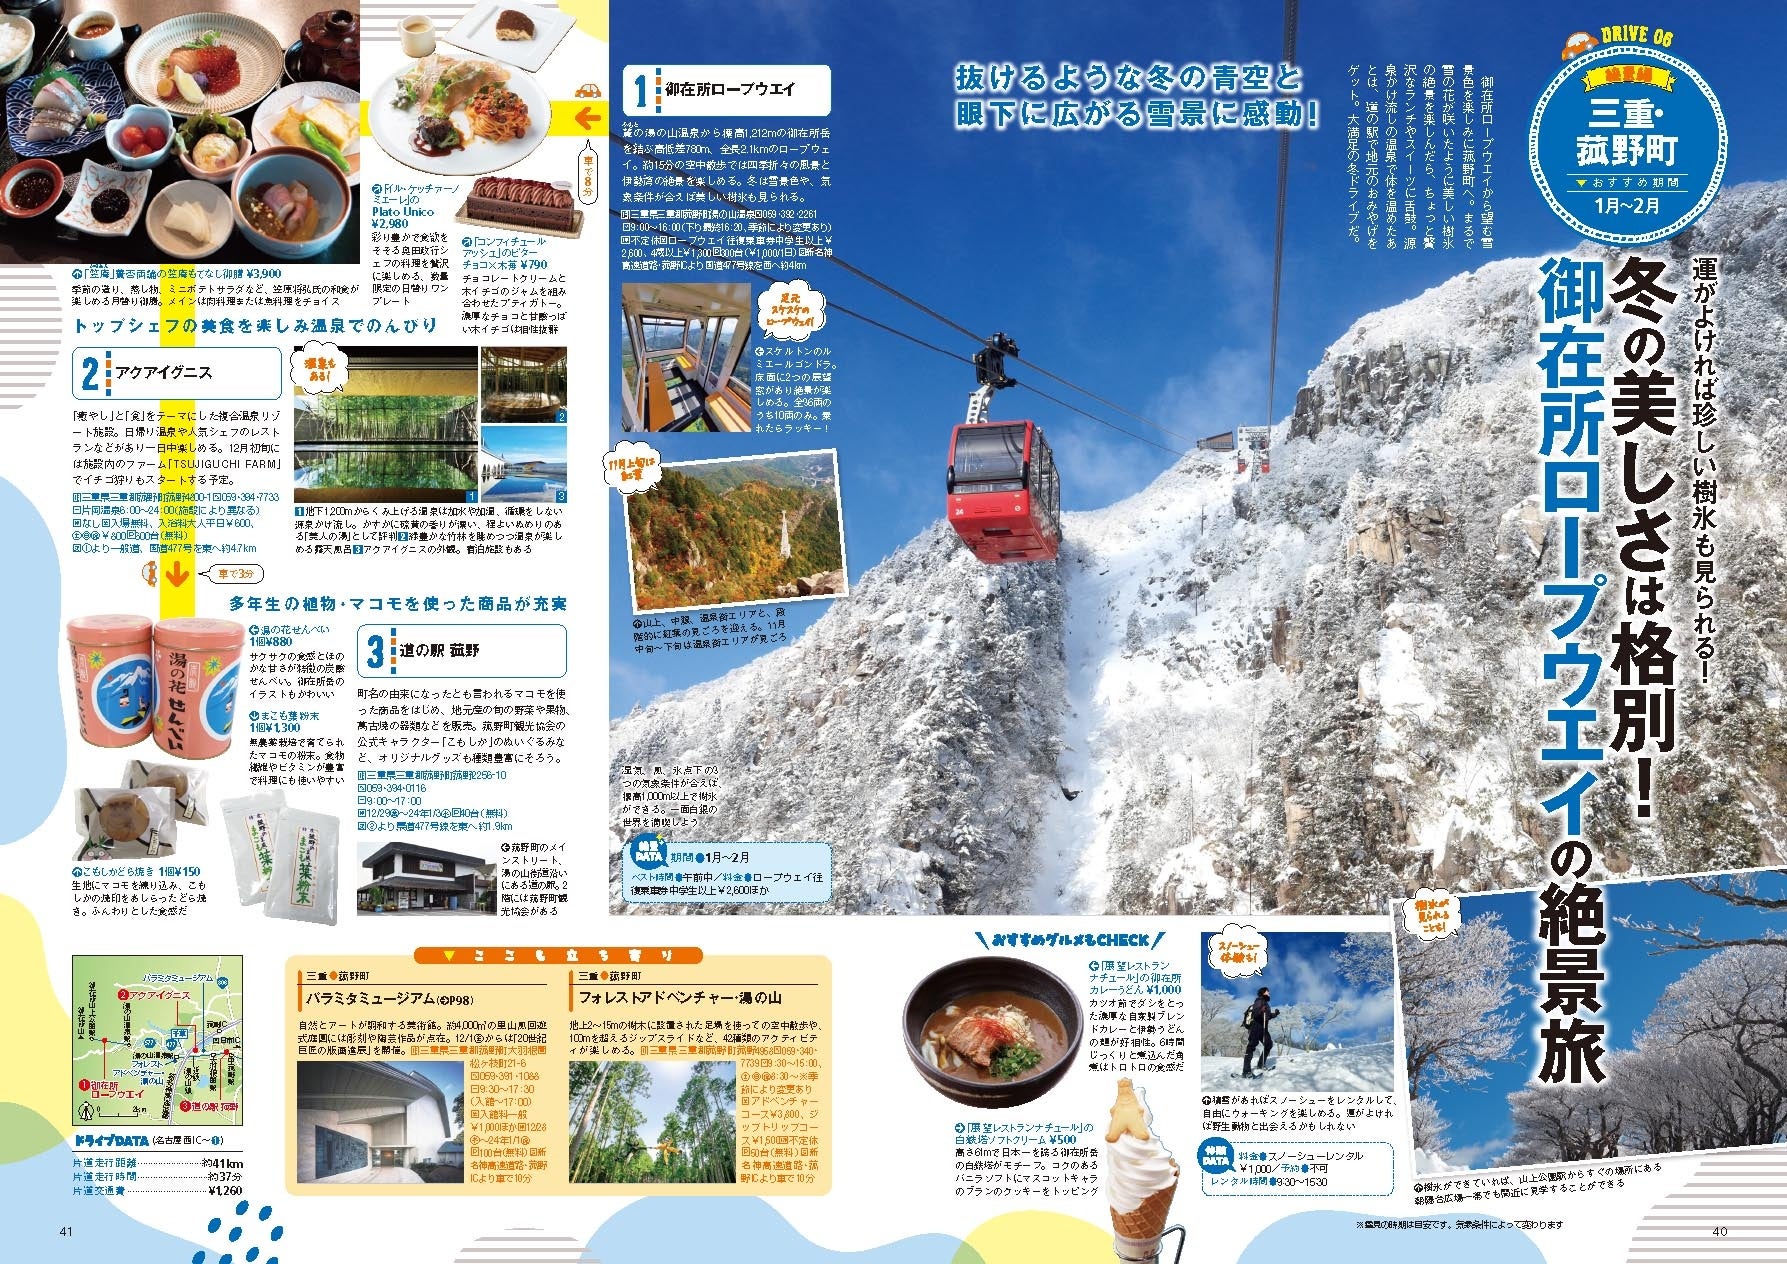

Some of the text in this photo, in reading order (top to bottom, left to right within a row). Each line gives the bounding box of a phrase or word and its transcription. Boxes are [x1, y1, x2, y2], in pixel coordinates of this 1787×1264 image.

[1601, 25, 1674, 47] DRIVE 06
[956, 64, 1301, 91] 抜けるような冬の青空と
[635, 75, 646, 107] 1
[665, 82, 795, 96] 御在所ロープウエイ
[958, 99, 1317, 127] 眼下に広がる雪景に感動!
[1347, 64, 1360, 243] ゲット。大満足の冬ドライブだ。
[1576, 134, 1679, 166] 菰野町
[1366, 64, 1379, 250] とは、道の駅で地元のおみやげを
[1385, 64, 1398, 249] 泉かけ流しの温泉で体を温めたあ
[1404, 64, 1417, 250] 沢なランチやスイーツに舌鼓。源
[1442, 64, 1455, 249] 雪の花が咲いたように美しい樹氷
[1462, 64, 1476, 249] 景色を楽しみに菰野町へ。まるで
[583, 156, 593, 196] 車で8分
[1593, 177, 1679, 188] おすすめ期間
[373, 207, 434, 216] Plato Unico
[372, 219, 408, 229] ¥2,980
[372, 232, 447, 242] 彩り豊かで食欲を
[521, 260, 547, 269] ¥790
[247, 269, 281, 279] ¥3,900
[373, 272, 448, 281] に楽しめる、数量
[463, 274, 565, 283] チョコレートクリームと
[373, 284, 448, 293] 限定の日替りワン
[462, 287, 566, 296] 木イチゴのジャムを組み
[373, 297, 409, 305] プレート
[77, 318, 435, 334] トップシェフの美食を楽しみ温泉でのんびり
[463, 325, 558, 334] い木イチゴは相性抜群
[765, 347, 832, 356] スケルトンのル
[82, 357, 98, 390] 2
[116, 365, 212, 379] アクアイグニス
[73, 427, 279, 437] ート施設。日帰り温泉や人気シェフのレスト
[73, 443, 279, 453] ランなどがあり一日中楽しめる。12月初旬に
[246, 459, 280, 469] FARM」
[1692, 256, 1718, 685] 運がよければ珍しい樹氷も見られる!
[73, 475, 233, 485] でイチゴ狩りもスタートする予定。
[1610, 256, 1678, 818] 冬の美しさは格別!
[219, 569, 254, 579] 車で3分
[230, 596, 566, 611] 多年生の植物・マコモを使った商品が充実
[367, 635, 384, 668] 3
[400, 643, 479, 657] 道の駅 菰野
[250, 651, 344, 664] サクサクの食感とほの
[1536, 256, 1608, 1084] 御在所ロープウエイの絶景旅
[250, 690, 334, 699] イラストもかわいい
[358, 688, 565, 699] 町名の由来になったとも言われるマコモを使
[168, 652, 187, 750] 湯の花せんべい
[358, 737, 564, 747] 公式キャラクター「こもしか」のぬいぐるみな
[359, 753, 560, 763] ど、オリジナルグッズも種類豊富にそろう。
[250, 776, 344, 785] で料理にも使いやすい
[503, 856, 561, 865] ンストリート、
[671, 853, 694, 863] 期間
[501, 907, 557, 916] 光協会がある
[991, 933, 1150, 947] おすすめグルメもCHECK
[1090, 973, 1181, 983] ナチュール」の御在所
[1090, 985, 1181, 995] カレーうどん ¥1,000
[306, 992, 435, 1005] パラミタミュージアム
[580, 991, 781, 1004] フォレストアドベンチャー・湯の山
[1089, 1062, 1184, 1072] 煮はトロトロの食感だ
[1204, 1109, 1393, 1118] 自由にウォーキングを楽しめる。運がよけれ
[1203, 1121, 1355, 1131] ば野生動物と出会えるかもしれない
[76, 1135, 149, 1147] ドライブDATA
[1050, 1135, 1076, 1144] ¥500
[1239, 1152, 1363, 1161] 料金 スノーシューレンタル
[202, 1158, 243, 1168] 約41km
[1310, 1164, 1328, 1173] 不可
[73, 1172, 242, 1181] 片道走行時間 約37分
[956, 1174, 1097, 1183] バニラソフトにマスコットキャラ
[1211, 1177, 1268, 1186] レンタル時間
[73, 1186, 242, 1196] 片道交通費 ¥1,260
[60, 1227, 72, 1236] 41
[1712, 1226, 1728, 1237] 40
